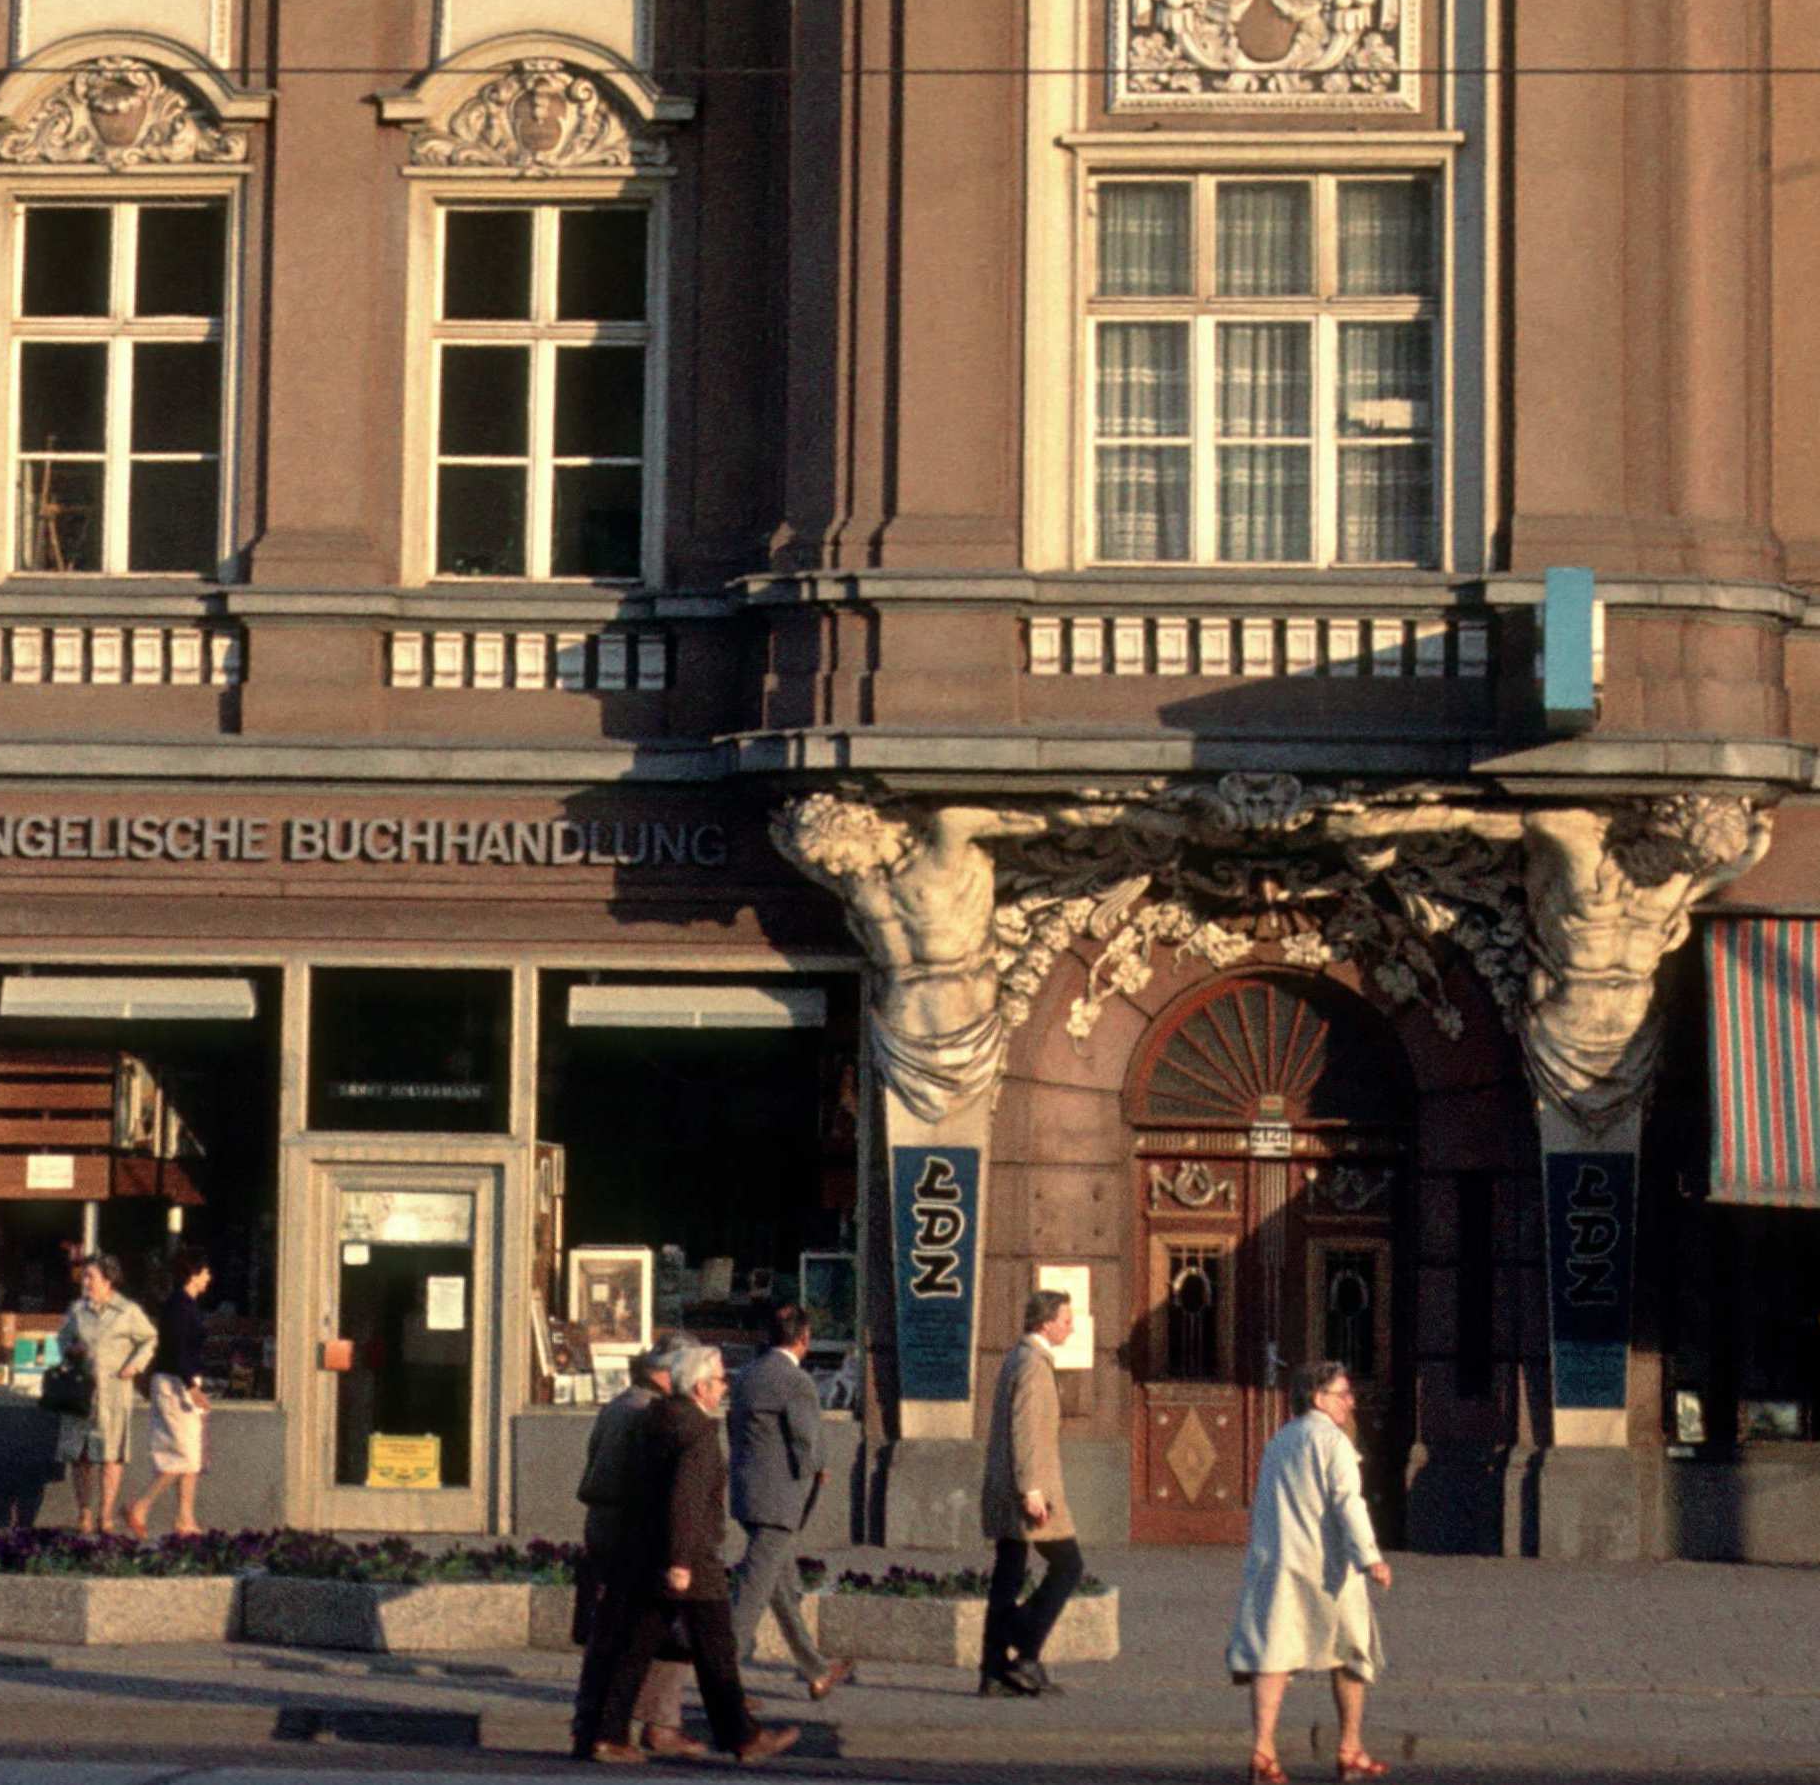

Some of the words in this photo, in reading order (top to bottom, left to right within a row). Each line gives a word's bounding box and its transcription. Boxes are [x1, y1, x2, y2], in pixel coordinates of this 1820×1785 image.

[289, 817, 728, 866] BUCHHANDLUNG
[911, 1154, 965, 1299] LDZ
[1565, 1164, 1620, 1307] LDZ
